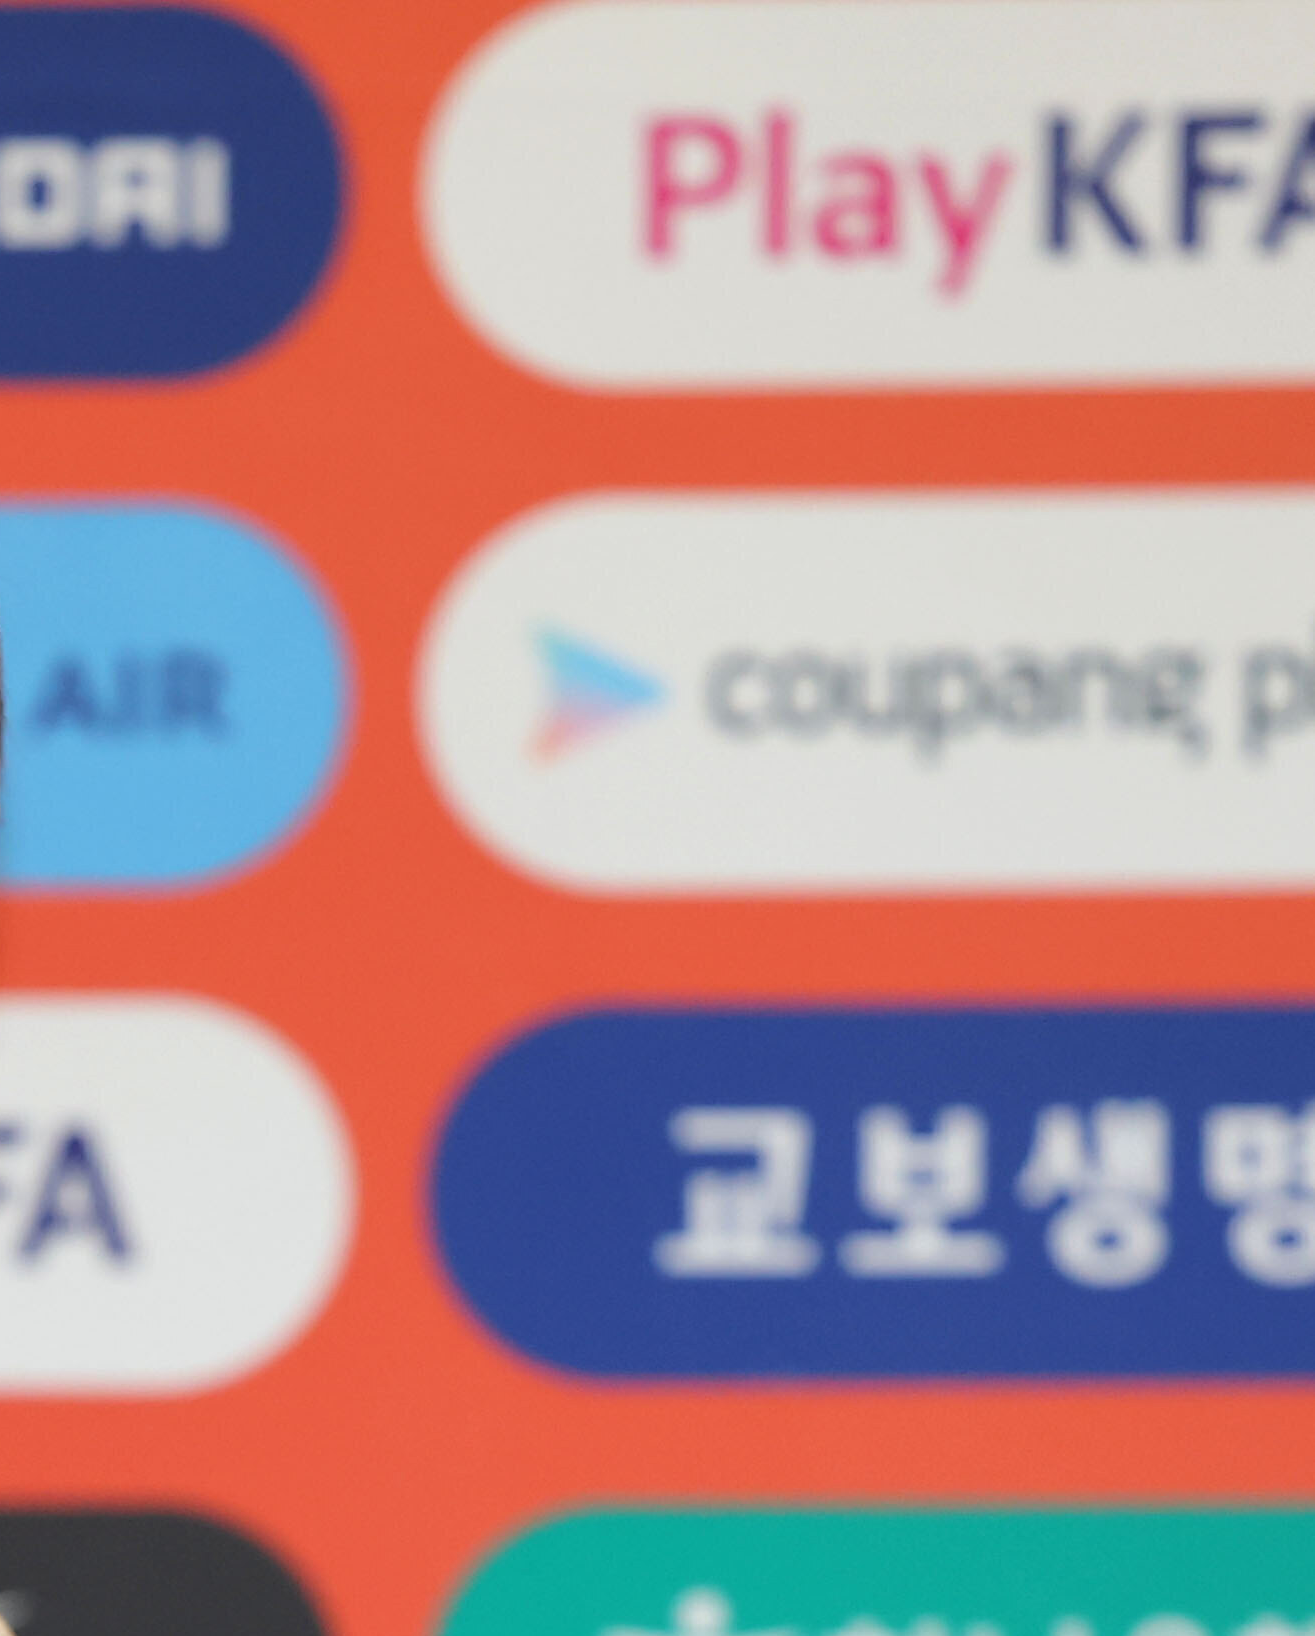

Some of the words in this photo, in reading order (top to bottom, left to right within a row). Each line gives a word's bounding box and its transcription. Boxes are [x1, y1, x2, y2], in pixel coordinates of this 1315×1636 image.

[25, 640, 235, 744] AIR
[703, 640, 1211, 764] coupang
[1240, 612, 1315, 766] p
